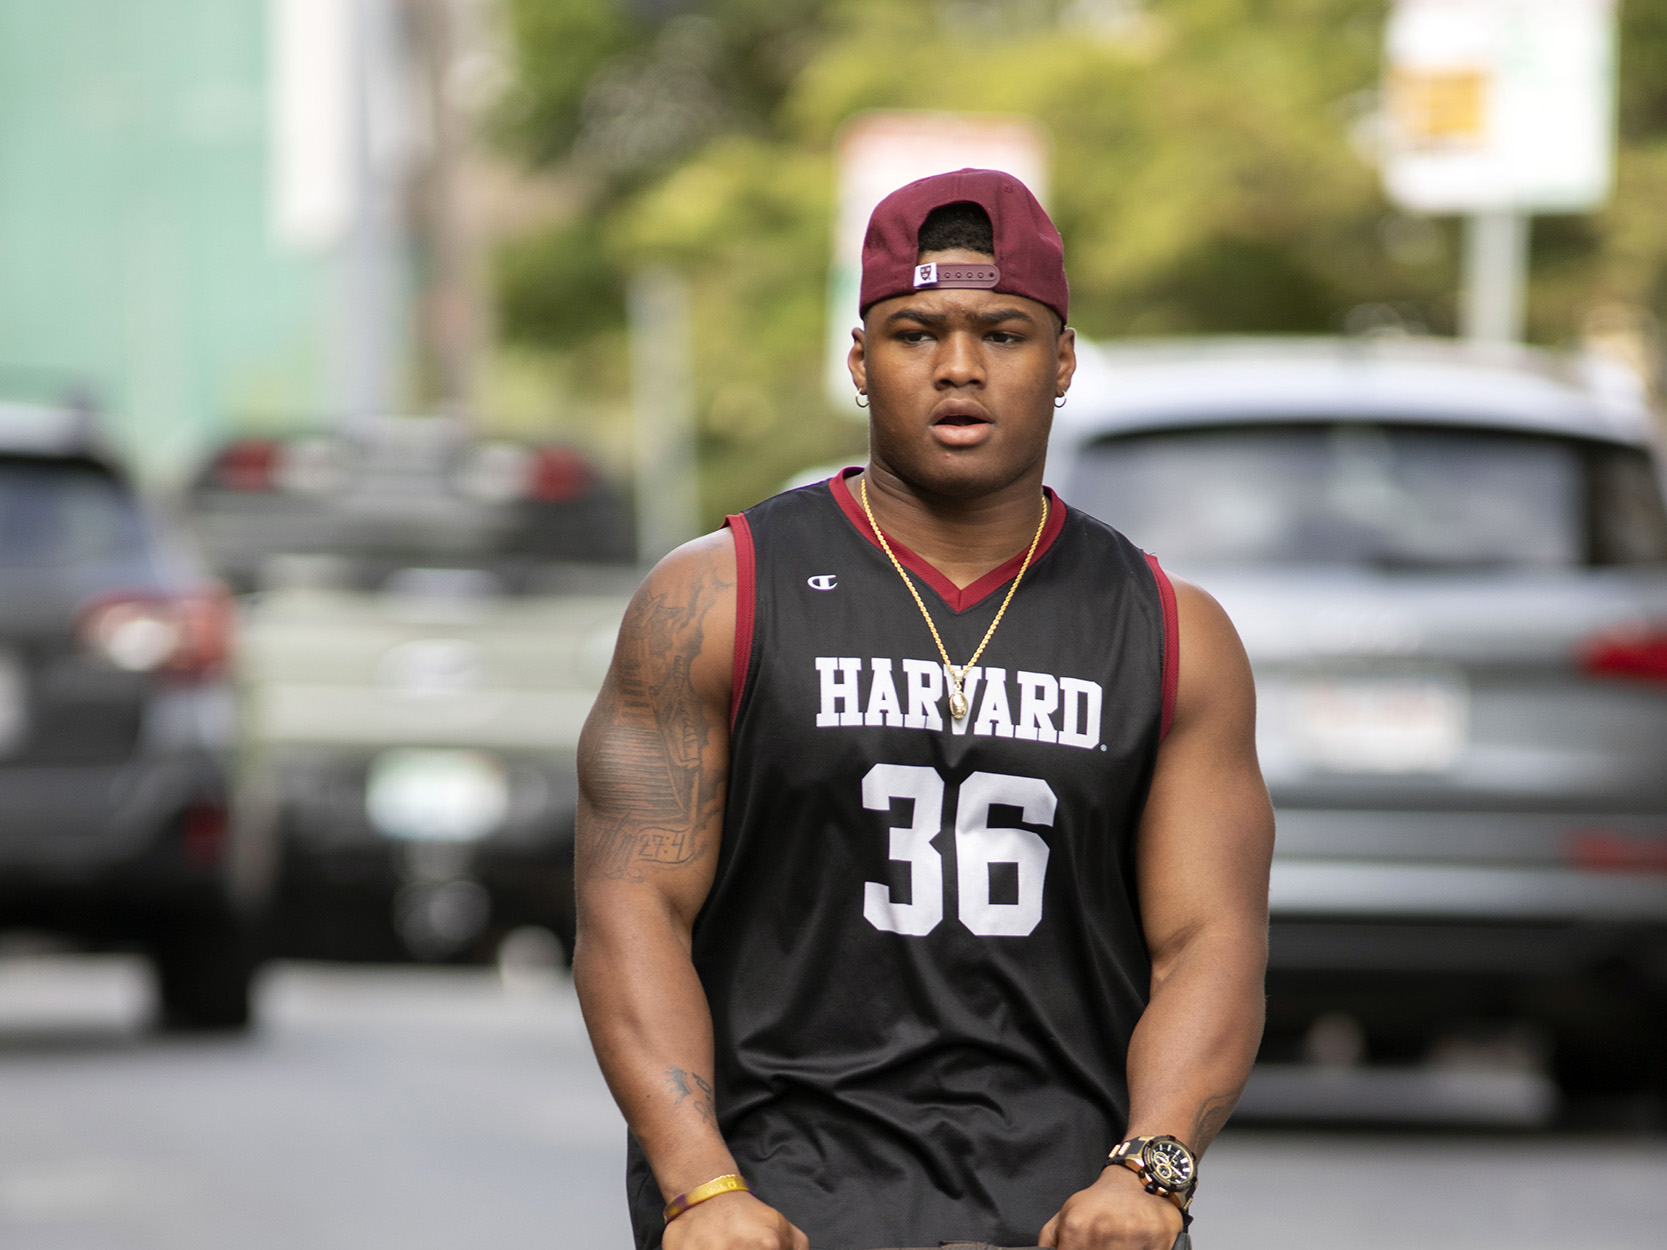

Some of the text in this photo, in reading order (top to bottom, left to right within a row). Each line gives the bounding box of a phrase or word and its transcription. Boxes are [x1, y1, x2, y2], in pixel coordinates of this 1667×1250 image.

[815, 656, 1103, 749] HARVARD
[637, 832, 687, 861] 27:4
[861, 762, 1058, 937] 36
